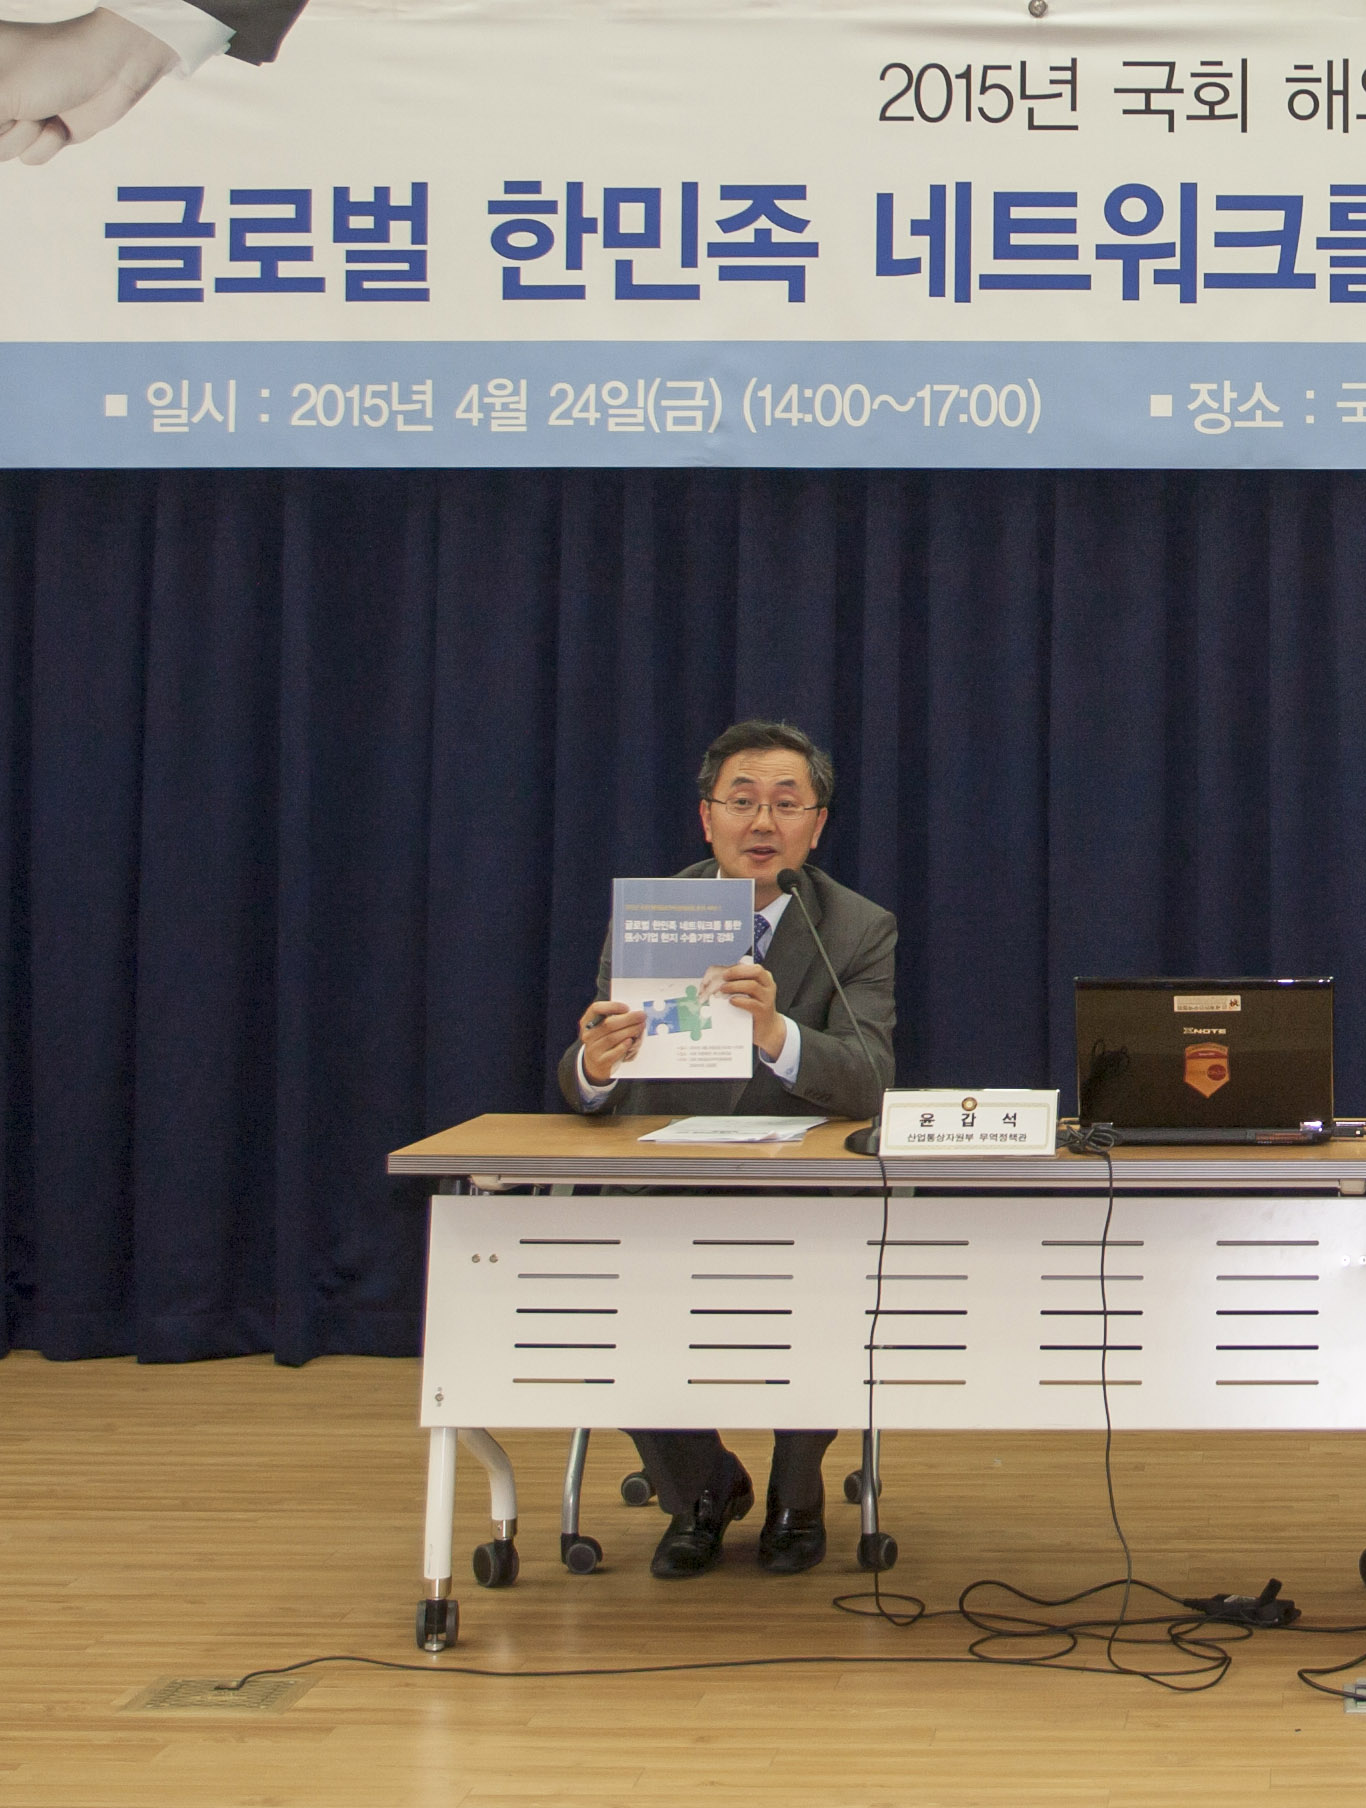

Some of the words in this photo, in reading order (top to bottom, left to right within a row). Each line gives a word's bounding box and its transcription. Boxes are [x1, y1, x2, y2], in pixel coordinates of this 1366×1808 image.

[878, 57, 1079, 132] 2015년
[1113, 57, 1249, 134] 국회
[104, 182, 430, 303] 글로벌
[487, 180, 819, 303] 한민족
[146, 379, 237, 433] 일시
[290, 379, 434, 433] 2015년
[456, 378, 527, 433] 4월
[547, 377, 722, 433] 24일(금)
[743, 377, 1042, 433] (14:00~17:00)
[1187, 380, 1284, 435] 장소
[907, 1132, 974, 1143] 산업통상자원부
[979, 1132, 1027, 1143] 무역정책관
